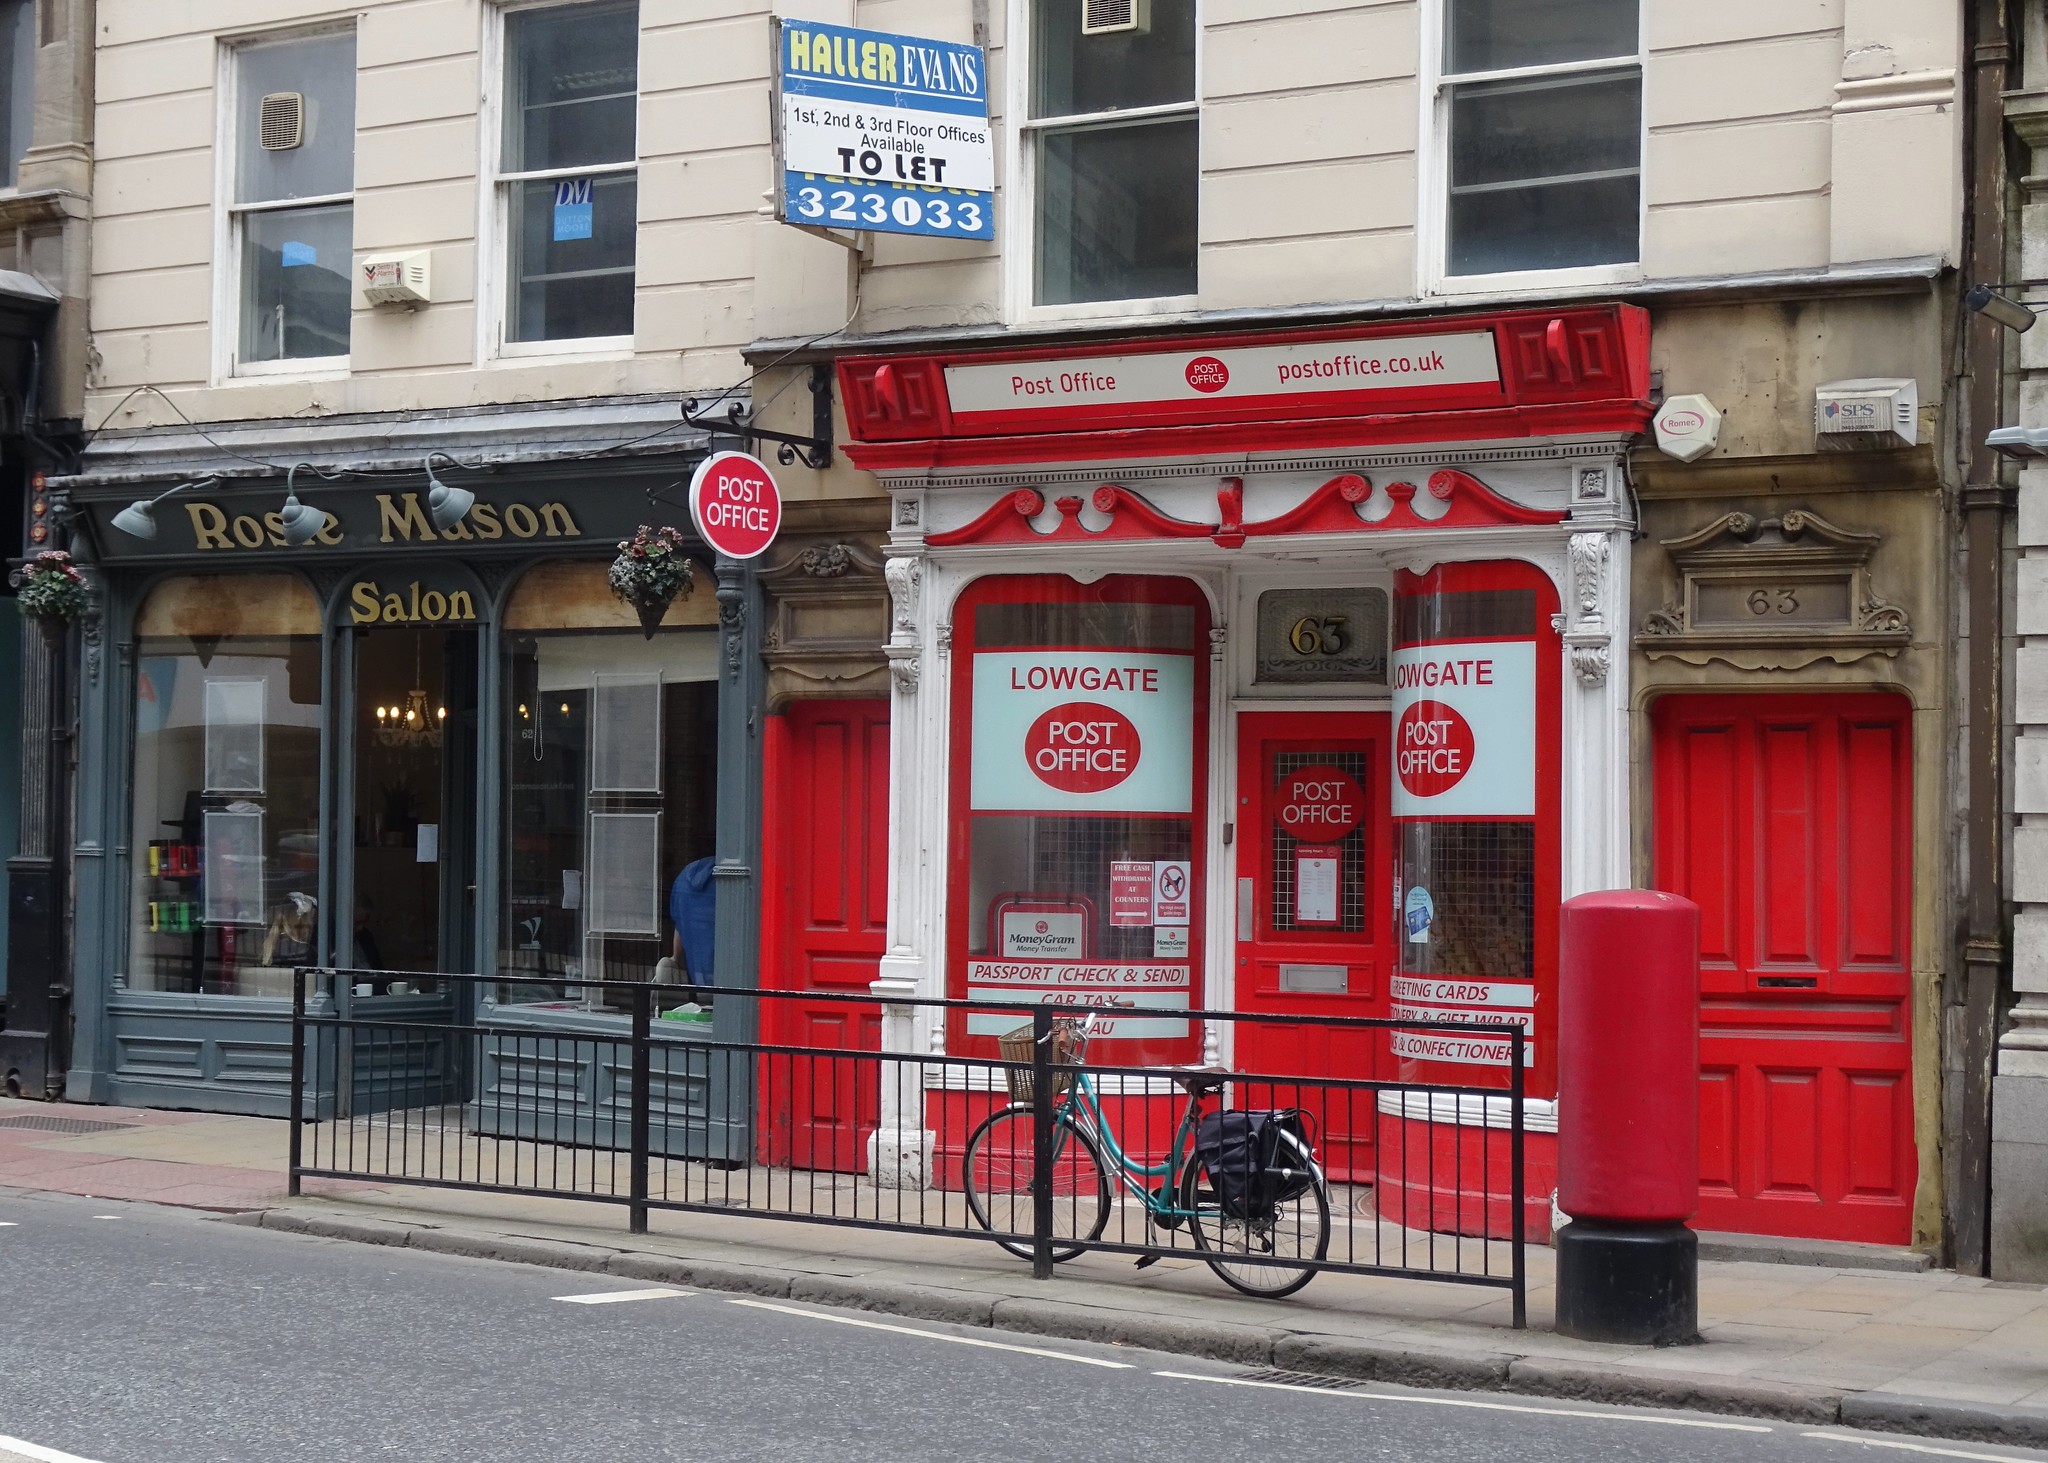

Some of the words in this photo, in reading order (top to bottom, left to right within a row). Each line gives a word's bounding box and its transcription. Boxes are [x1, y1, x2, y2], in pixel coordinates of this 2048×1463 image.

[790, 29, 897, 83] HALLER
[901, 45, 977, 95] EVANS
[793, 107, 819, 127] 1st,
[824, 111, 850, 128] 2nd
[855, 115, 866, 130] &
[870, 116, 892, 133] 3rd
[897, 120, 933, 138] Floor
[937, 125, 985, 144] Offices
[860, 133, 925, 154] Available
[837, 147, 883, 176] TO
[895, 154, 947, 183] LET
[555, 179, 592, 206] DM
[798, 187, 983, 232] 323033
[1190, 373, 1226, 385] OFFICE
[1193, 363, 1219, 374] POST
[1277, 350, 1445, 384] postoffice.co.uk
[1012, 376, 1052, 396] Post
[1060, 372, 1116, 393] Office
[1841, 403, 1875, 417] SPS
[1668, 418, 1696, 428] Romec
[718, 475, 764, 503] POST
[184, 502, 344, 549] Rose
[706, 502, 769, 532] OFFICE
[349, 580, 476, 624] Salon
[1746, 588, 1800, 615] 63
[1289, 615, 1347, 655] 63
[1011, 666, 1159, 692] LOWGATE
[522, 729, 533, 739] 62
[1049, 721, 1118, 745] POST
[1405, 720, 1453, 746] POST
[1035, 748, 1127, 772] OFFICE
[1400, 749, 1461, 775] OFFICE
[1293, 781, 1346, 801] POST
[1282, 804, 1352, 824] OFFICE
[1114, 864, 1132, 872] FREE
[1133, 864, 1150, 872] CASH
[1009, 934, 1075, 945] MoneyGram
[1016, 945, 1040, 953] Money
[974, 965, 1053, 981] PASSPORT
[1057, 966, 1119, 983] (CHECK
[1122, 969, 1138, 982] &
[1142, 969, 1185, 984] SEND)
[1435, 984, 1490, 1001] CARDS
[1407, 1038, 1528, 1061] CONFECTIONER
